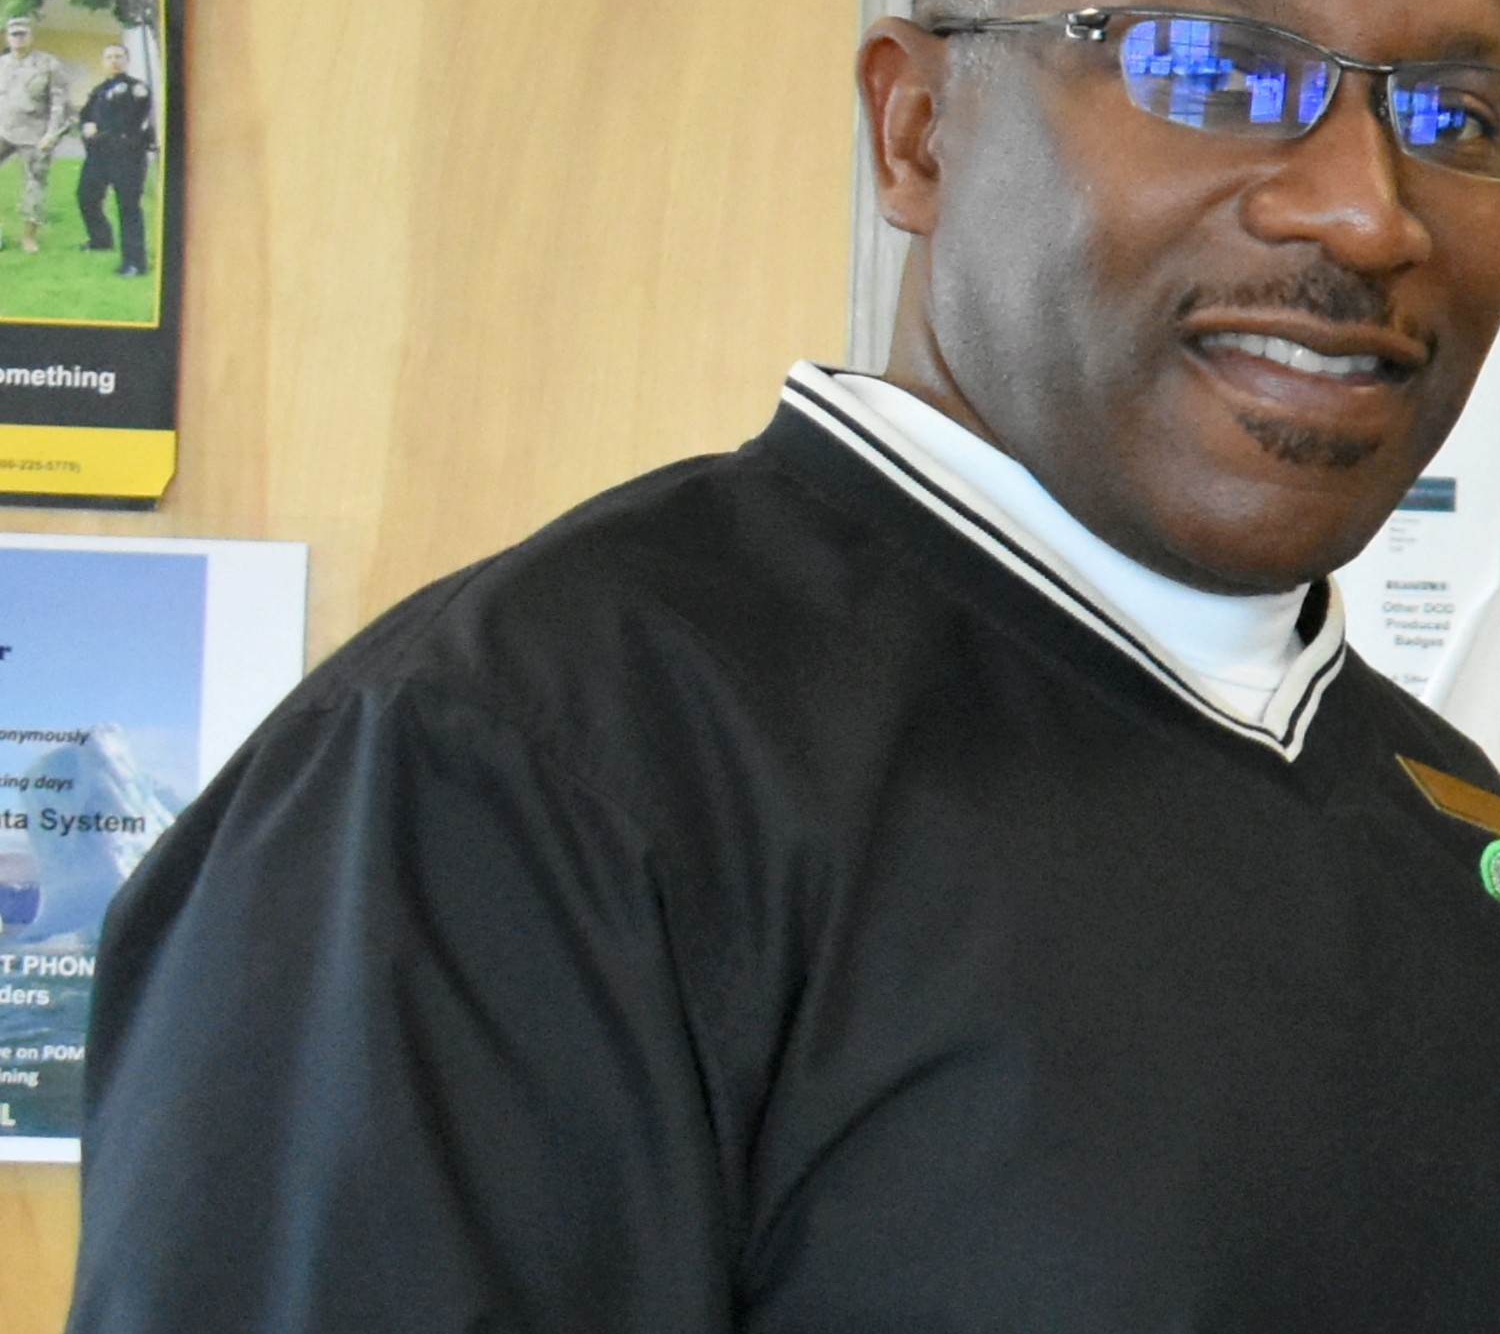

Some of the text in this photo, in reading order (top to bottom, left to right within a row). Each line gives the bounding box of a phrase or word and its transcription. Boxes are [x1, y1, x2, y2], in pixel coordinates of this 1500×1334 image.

[34, 774, 74, 794] days
[40, 807, 147, 837] System
[16, 1046, 39, 1060] on
